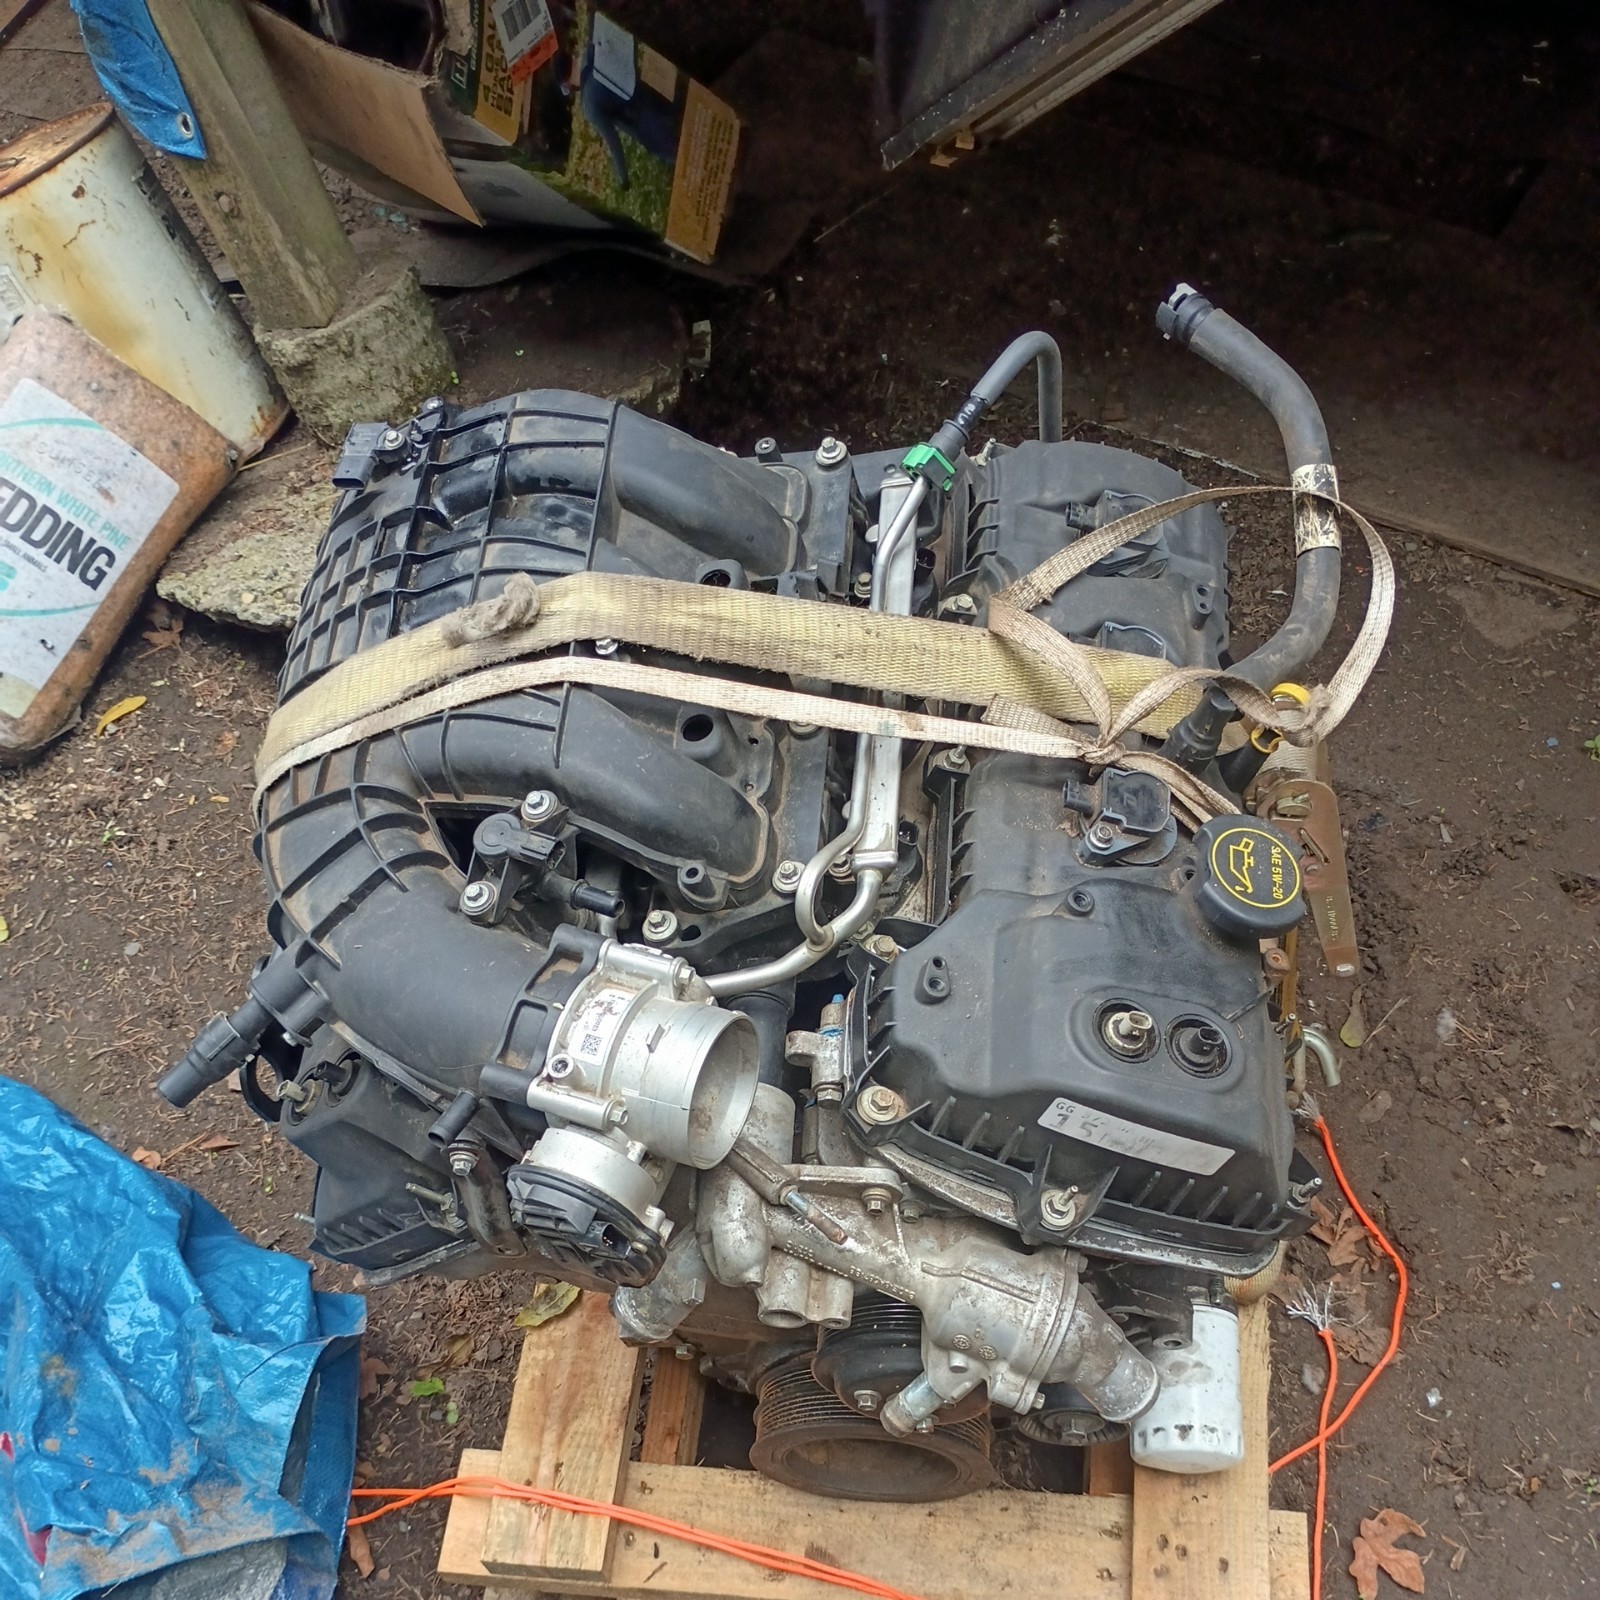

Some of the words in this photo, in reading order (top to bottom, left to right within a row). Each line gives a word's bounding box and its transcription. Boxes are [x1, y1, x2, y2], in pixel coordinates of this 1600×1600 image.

[56, 487, 100, 528] WHITE
[99, 522, 131, 551] PINE
[1271, 845, 1282, 866] SAE
[1271, 867, 1283, 900] 5W-20
[1056, 1101, 1076, 1114] GG
